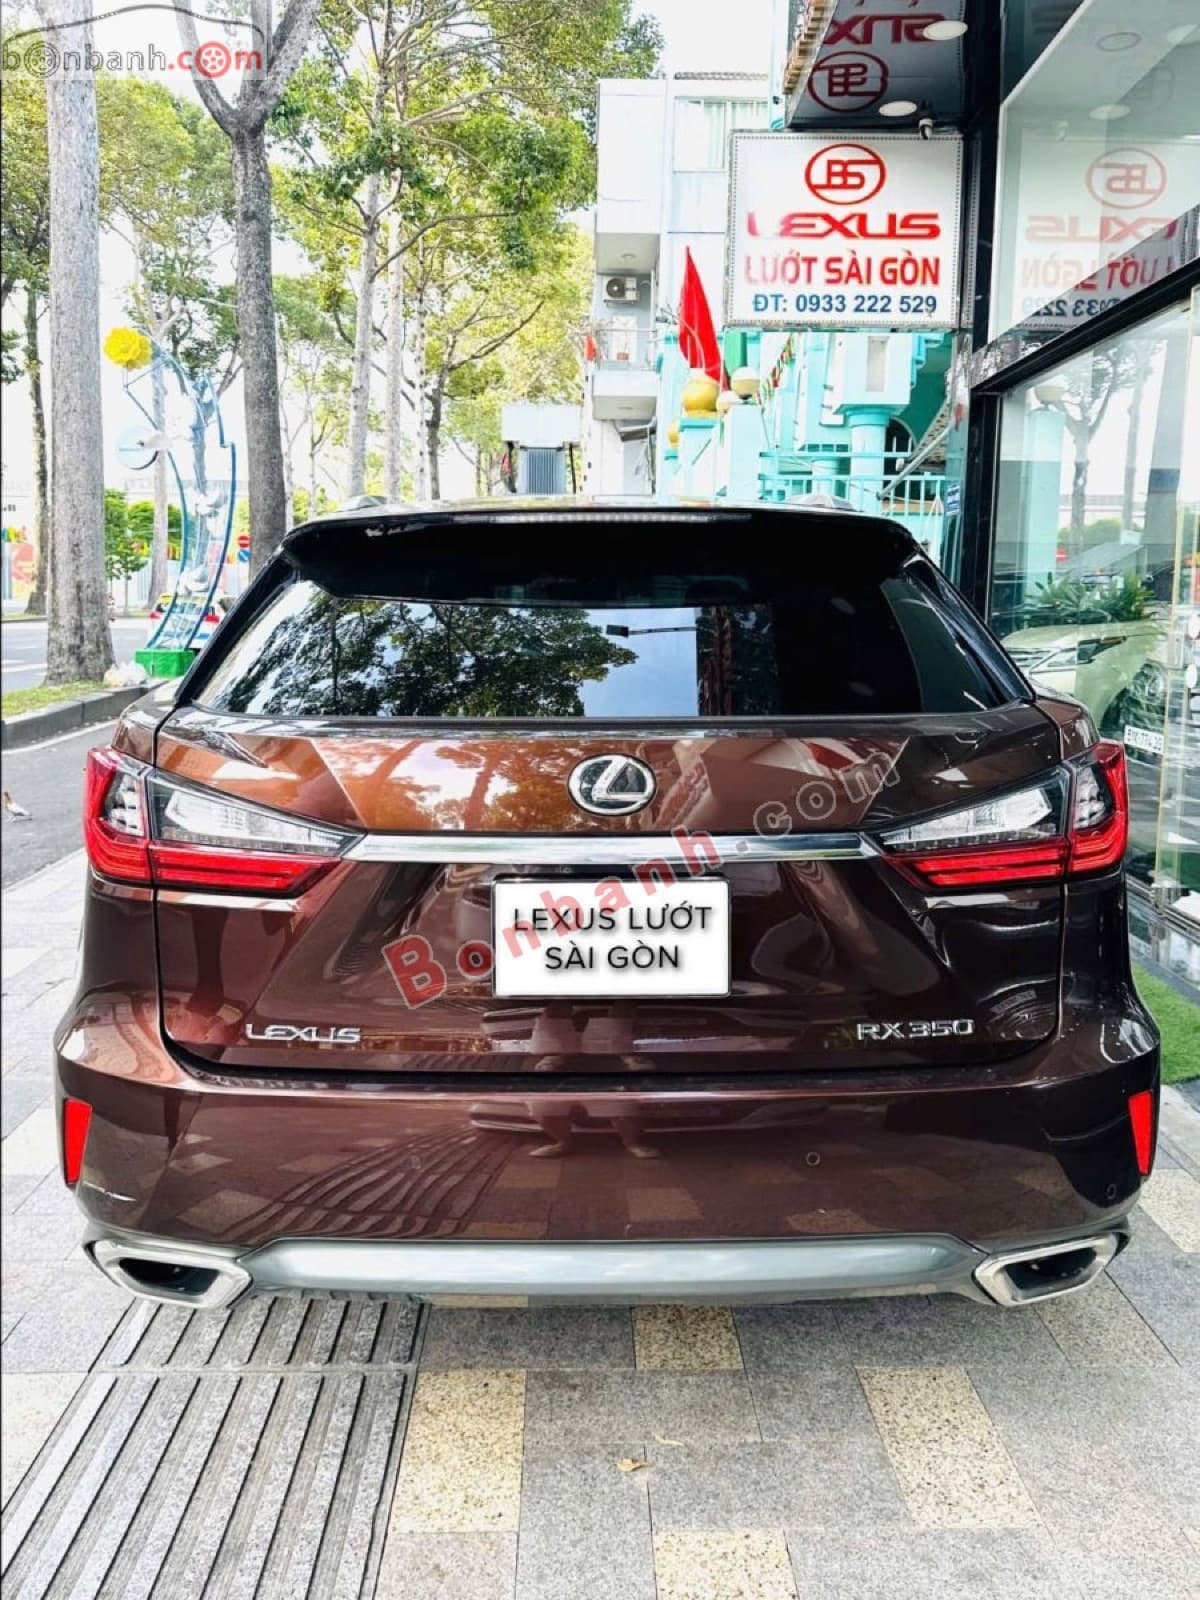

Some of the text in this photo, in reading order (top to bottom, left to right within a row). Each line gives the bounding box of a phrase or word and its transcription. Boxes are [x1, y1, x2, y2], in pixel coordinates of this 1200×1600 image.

[747, 211, 941, 240] LEXUS
[824, 248, 873, 286] SÀI
[879, 249, 941, 286] GÒN
[752, 293, 938, 315] ĐT: 0933 222 529
[245, 1023, 361, 1044] LEXUS
